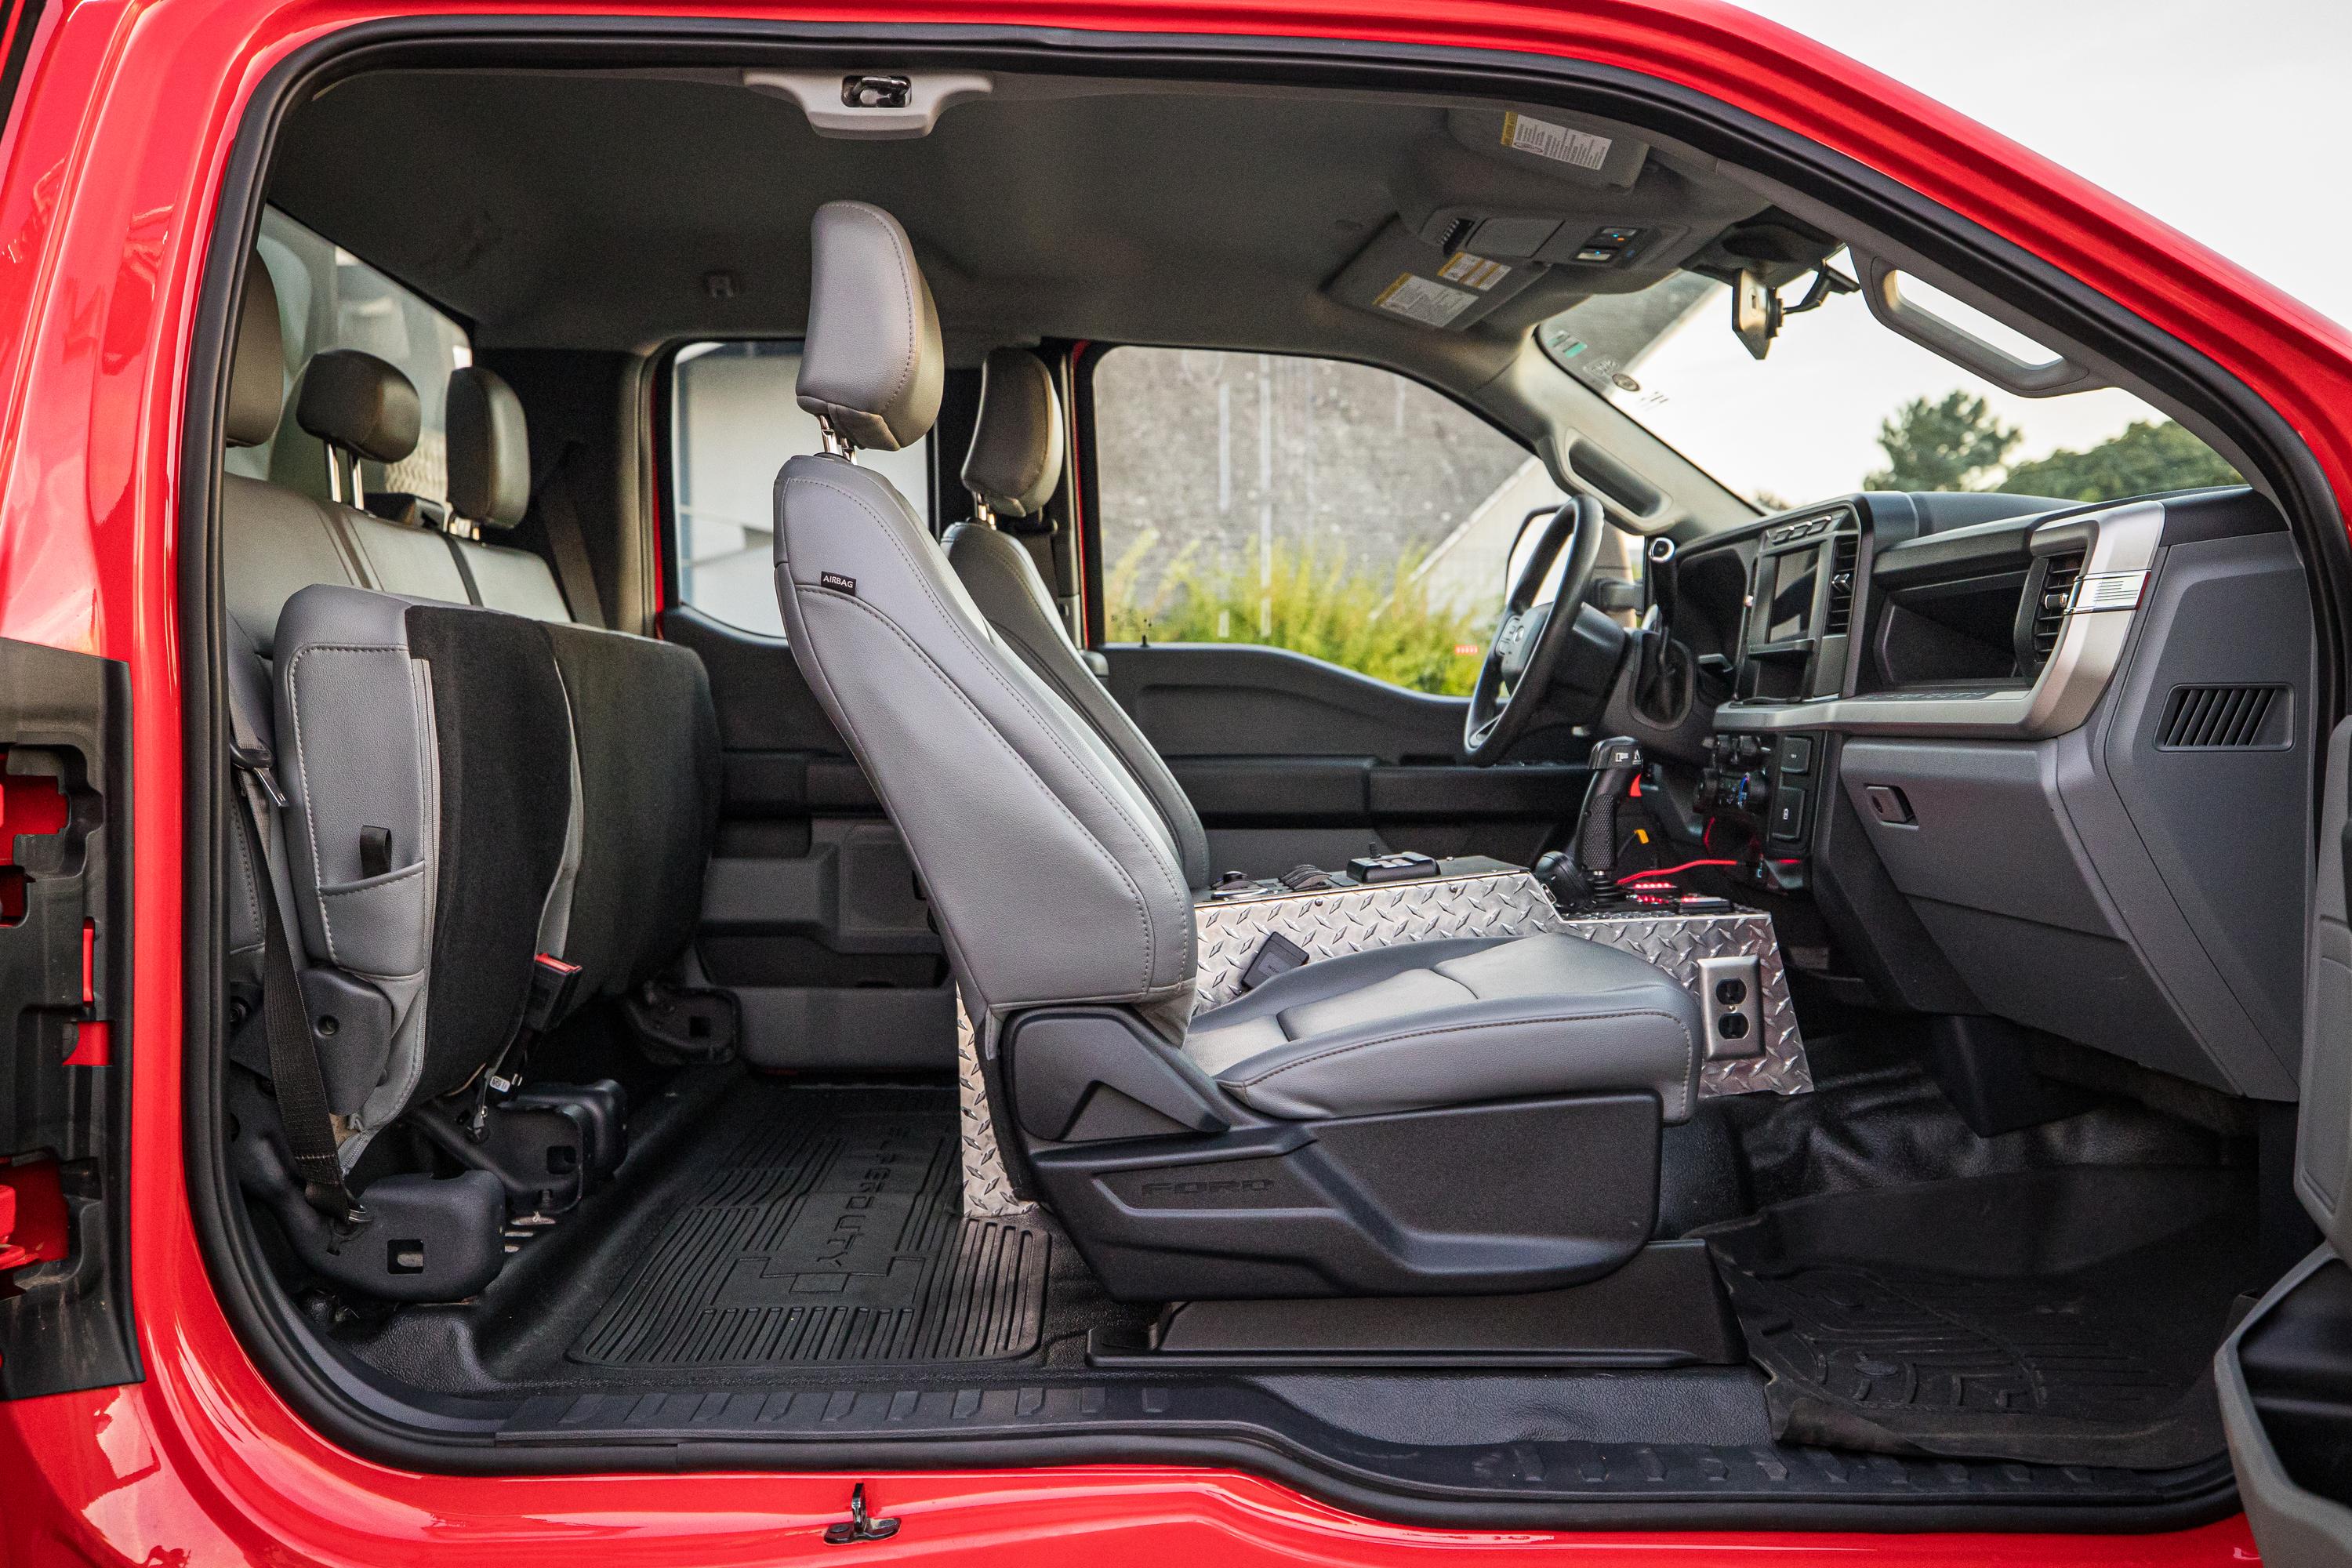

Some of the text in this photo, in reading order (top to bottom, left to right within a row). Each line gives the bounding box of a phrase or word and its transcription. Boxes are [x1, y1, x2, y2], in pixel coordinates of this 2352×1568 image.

[824, 575, 854, 589] AIRBAG
[1141, 1179, 1275, 1197] FORD
[815, 1196, 875, 1267] DUTY
